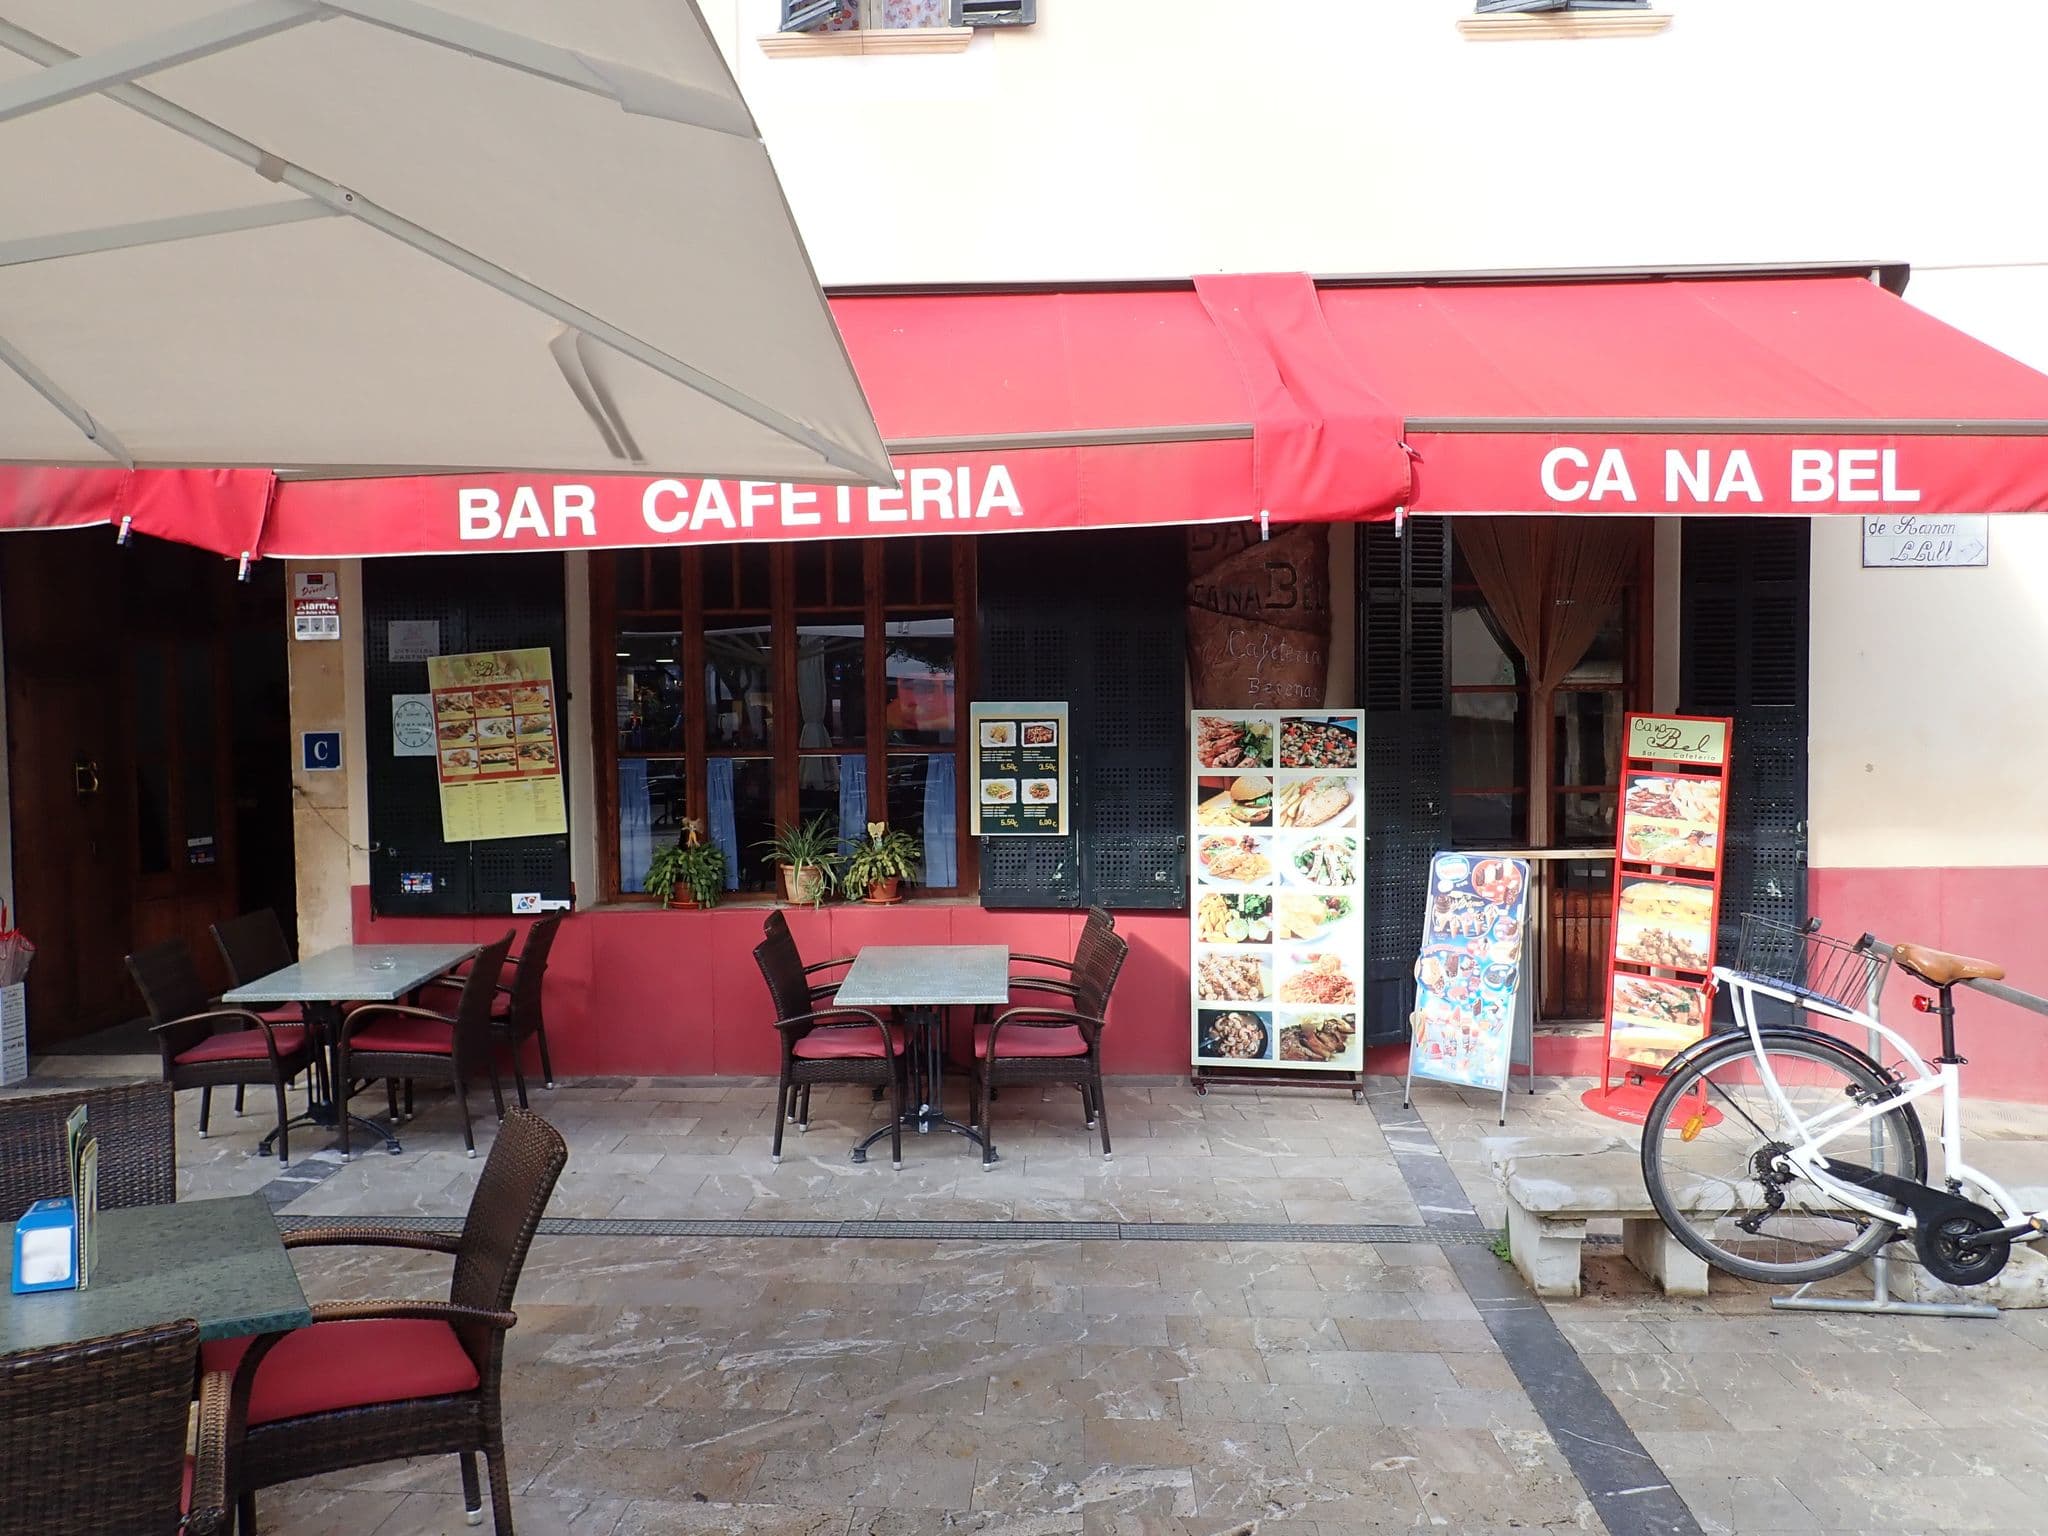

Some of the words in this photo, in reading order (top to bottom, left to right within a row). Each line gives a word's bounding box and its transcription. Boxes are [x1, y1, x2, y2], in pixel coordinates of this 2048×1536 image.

[1540, 447, 1637, 502] CA
[1664, 448, 1763, 502] NA
[1791, 448, 1921, 502] BEL
[458, 484, 598, 541] BAR
[641, 464, 1023, 535] CAFETERIA
[1868, 517, 1886, 535] de
[1893, 516, 1955, 535] Ramon
[314, 740, 328, 761] C
